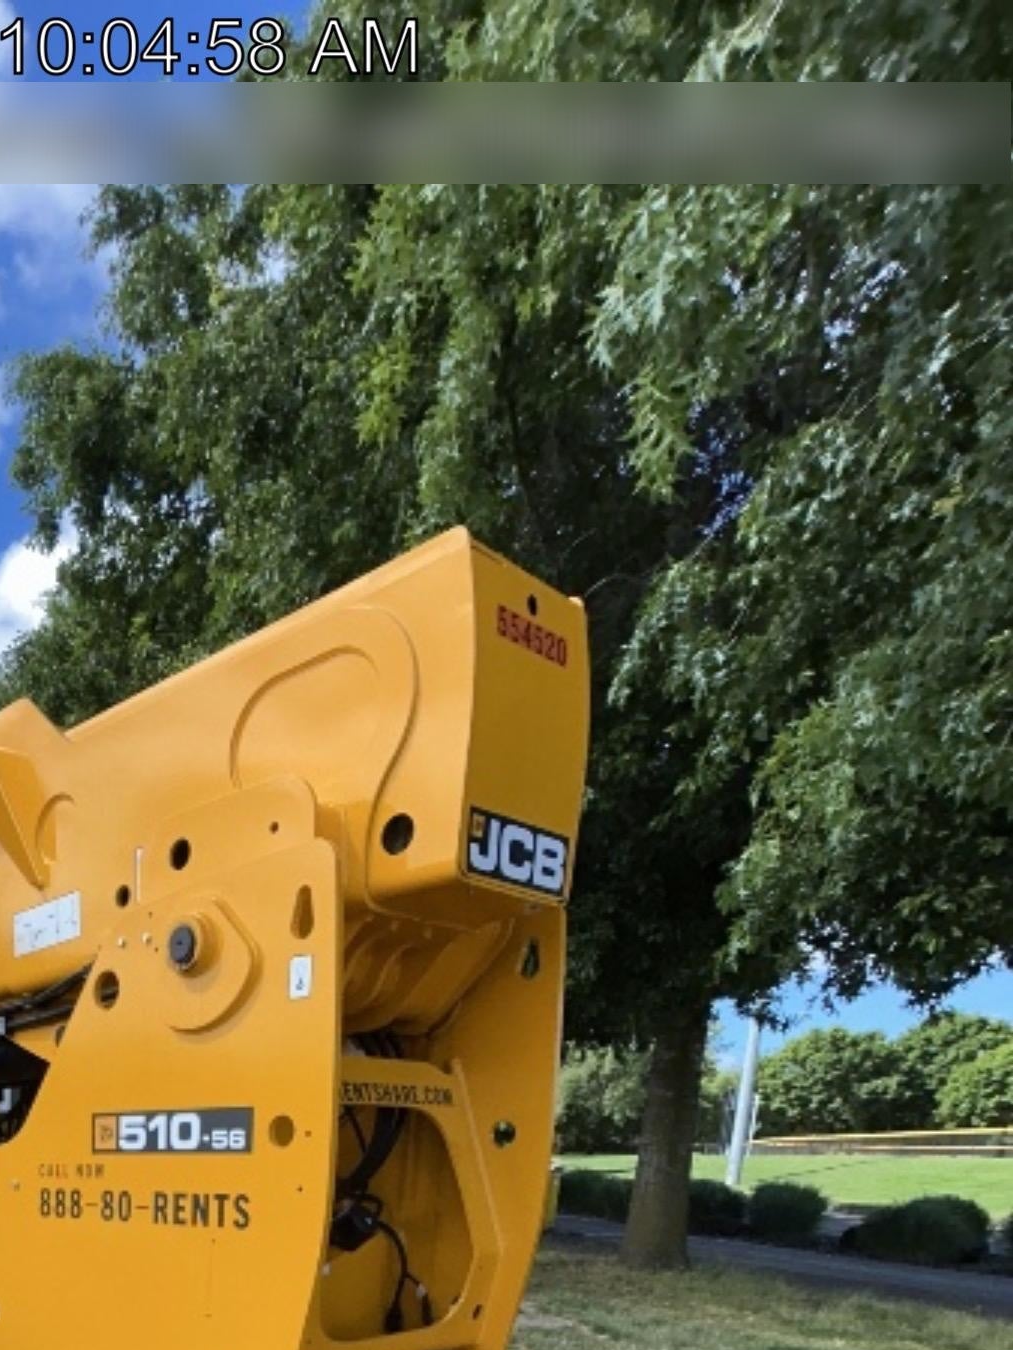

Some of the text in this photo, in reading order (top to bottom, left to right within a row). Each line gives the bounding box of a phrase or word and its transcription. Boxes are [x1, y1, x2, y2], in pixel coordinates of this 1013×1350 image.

[469, 817, 567, 891] JCB
[340, 1082, 453, 1105] ENTSHARE.COM
[37, 1163, 69, 1179] CALL
[39, 1187, 251, 1230] 888-80-RENTS
